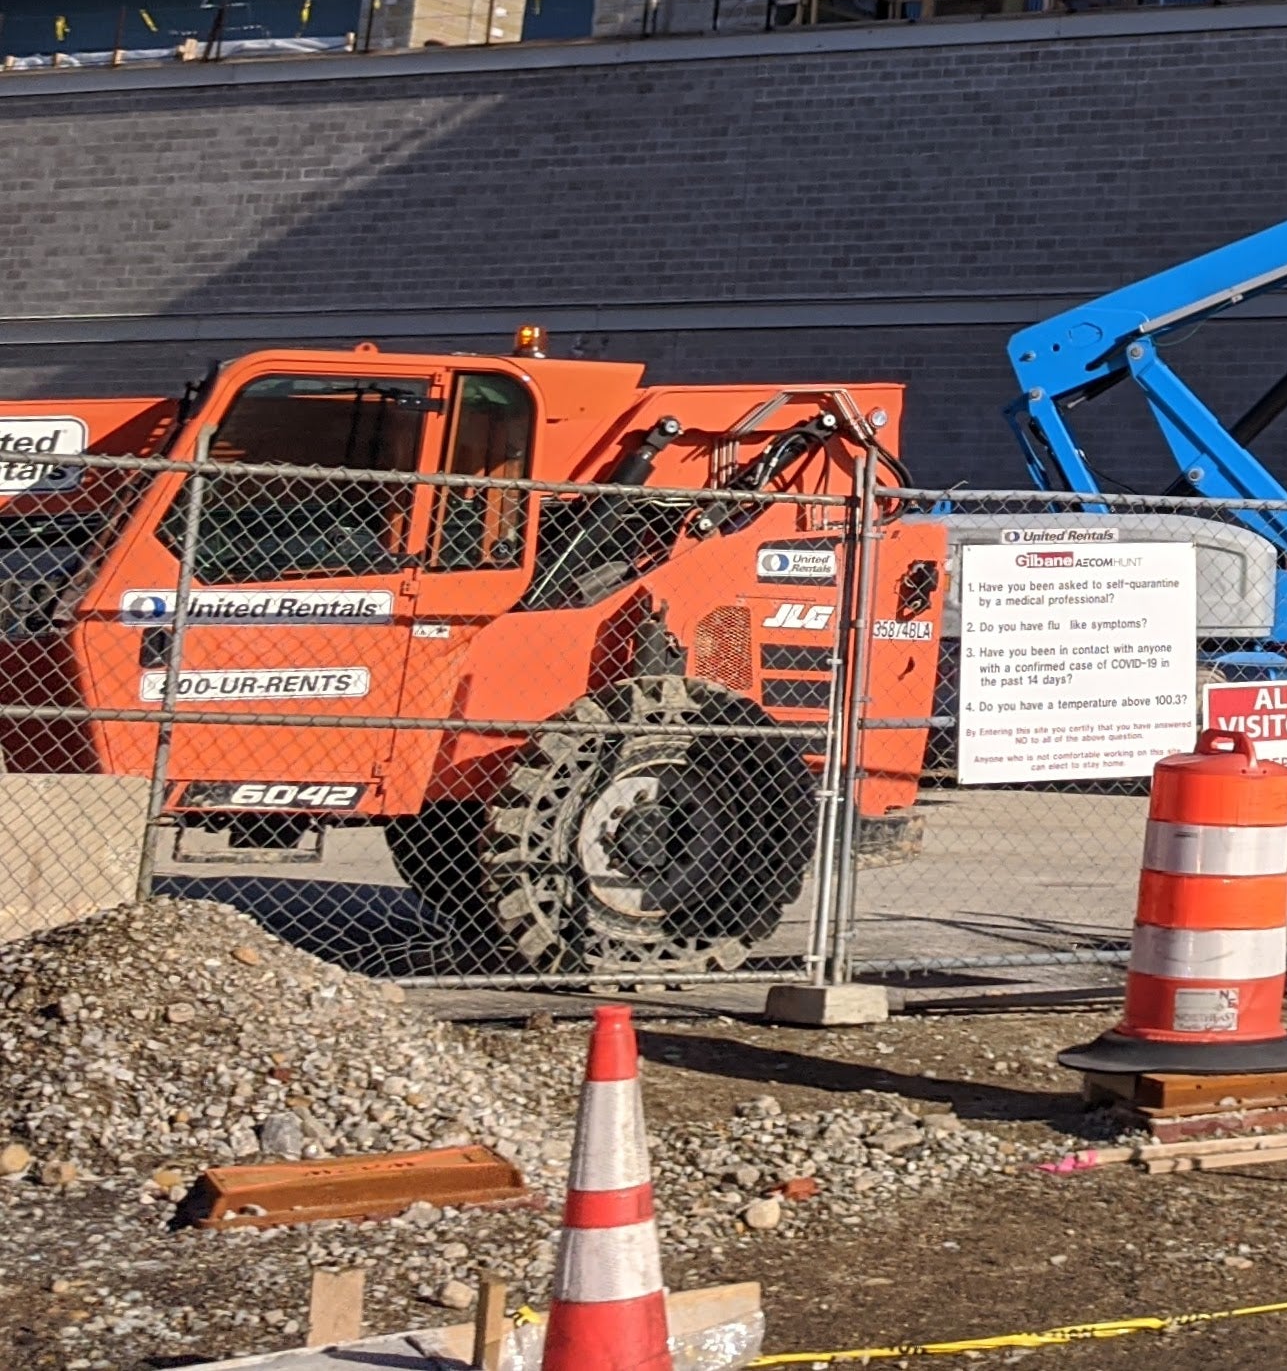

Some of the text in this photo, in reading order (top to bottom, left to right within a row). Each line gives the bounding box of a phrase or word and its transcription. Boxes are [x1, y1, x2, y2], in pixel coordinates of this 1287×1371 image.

[0, 430, 60, 453] ted
[1023, 530, 1113, 541] United Rentals
[792, 554, 830, 564] United
[1015, 552, 1073, 568] Gilbane
[791, 564, 831, 573] Rentals
[968, 579, 1179, 593] 1. Have you been asked to self-quarantine
[275, 597, 378, 618] Rentals
[979, 594, 1114, 607] by a medical professional?
[762, 604, 835, 629] JLG
[967, 618, 1147, 633] 2. Do you have flu like symptoms?
[966, 644, 1172, 659] 3. Have you been in contact with anyone
[979, 663, 1000, 673] with
[1015, 661, 1065, 672] confirmed
[1069, 662, 1093, 671] case
[1097, 659, 1107, 669] of
[1111, 659, 1157, 669] COVID-19
[1161, 659, 1170, 668] in
[981, 674, 1073, 688] the past 14 days?
[965, 702, 975, 712] 4.
[979, 702, 993, 712] Do
[998, 703, 1016, 713] you
[1020, 701, 1043, 710] have
[1058, 699, 1117, 710] temperature
[1121, 697, 1151, 707] above
[1155, 695, 1188, 705] 100.3?
[1052, 727, 1066, 735] you
[1098, 723, 1113, 732] that
[1116, 723, 1130, 732] you
[1133, 722, 1151, 730] have
[1154, 720, 1192, 729] answered
[1031, 736, 1039, 744] to
[1043, 735, 1051, 743] all
[1055, 735, 1063, 743] of
[1066, 734, 1078, 742] the
[1082, 733, 1105, 742] above
[974, 755, 1003, 765] Anyone
[1037, 753, 1050, 761] not
[1053, 751, 1100, 760] comfortable
[1104, 749, 1134, 759] working
[1048, 762, 1068, 770] elect
[231, 784, 357, 806] 6042
